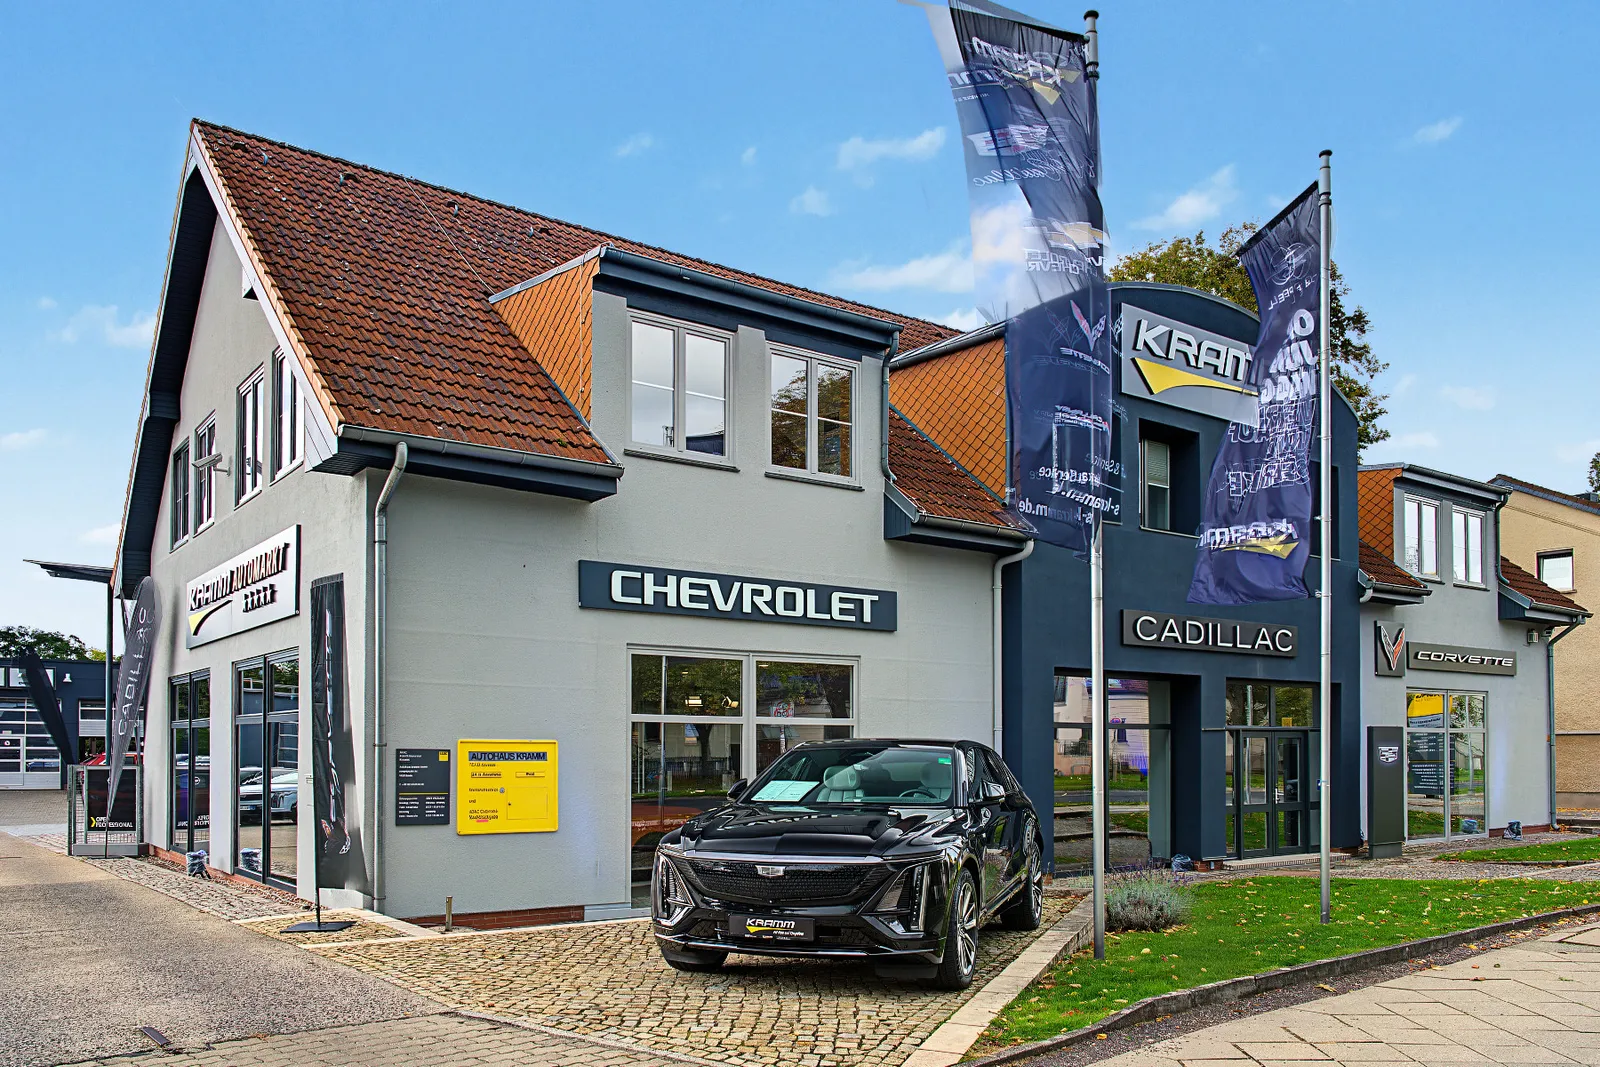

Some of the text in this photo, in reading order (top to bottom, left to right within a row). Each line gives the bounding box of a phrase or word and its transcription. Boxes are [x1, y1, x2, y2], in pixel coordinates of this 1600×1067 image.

[232, 542, 290, 592] AUTOMARKT
[611, 569, 879, 623] CHEVROLET
[1136, 616, 1293, 652] CADILLAC
[1417, 651, 1514, 667] CORVETTE
[471, 752, 546, 761] AUTOHAUS KRAMM
[746, 918, 796, 929] KRAMM
